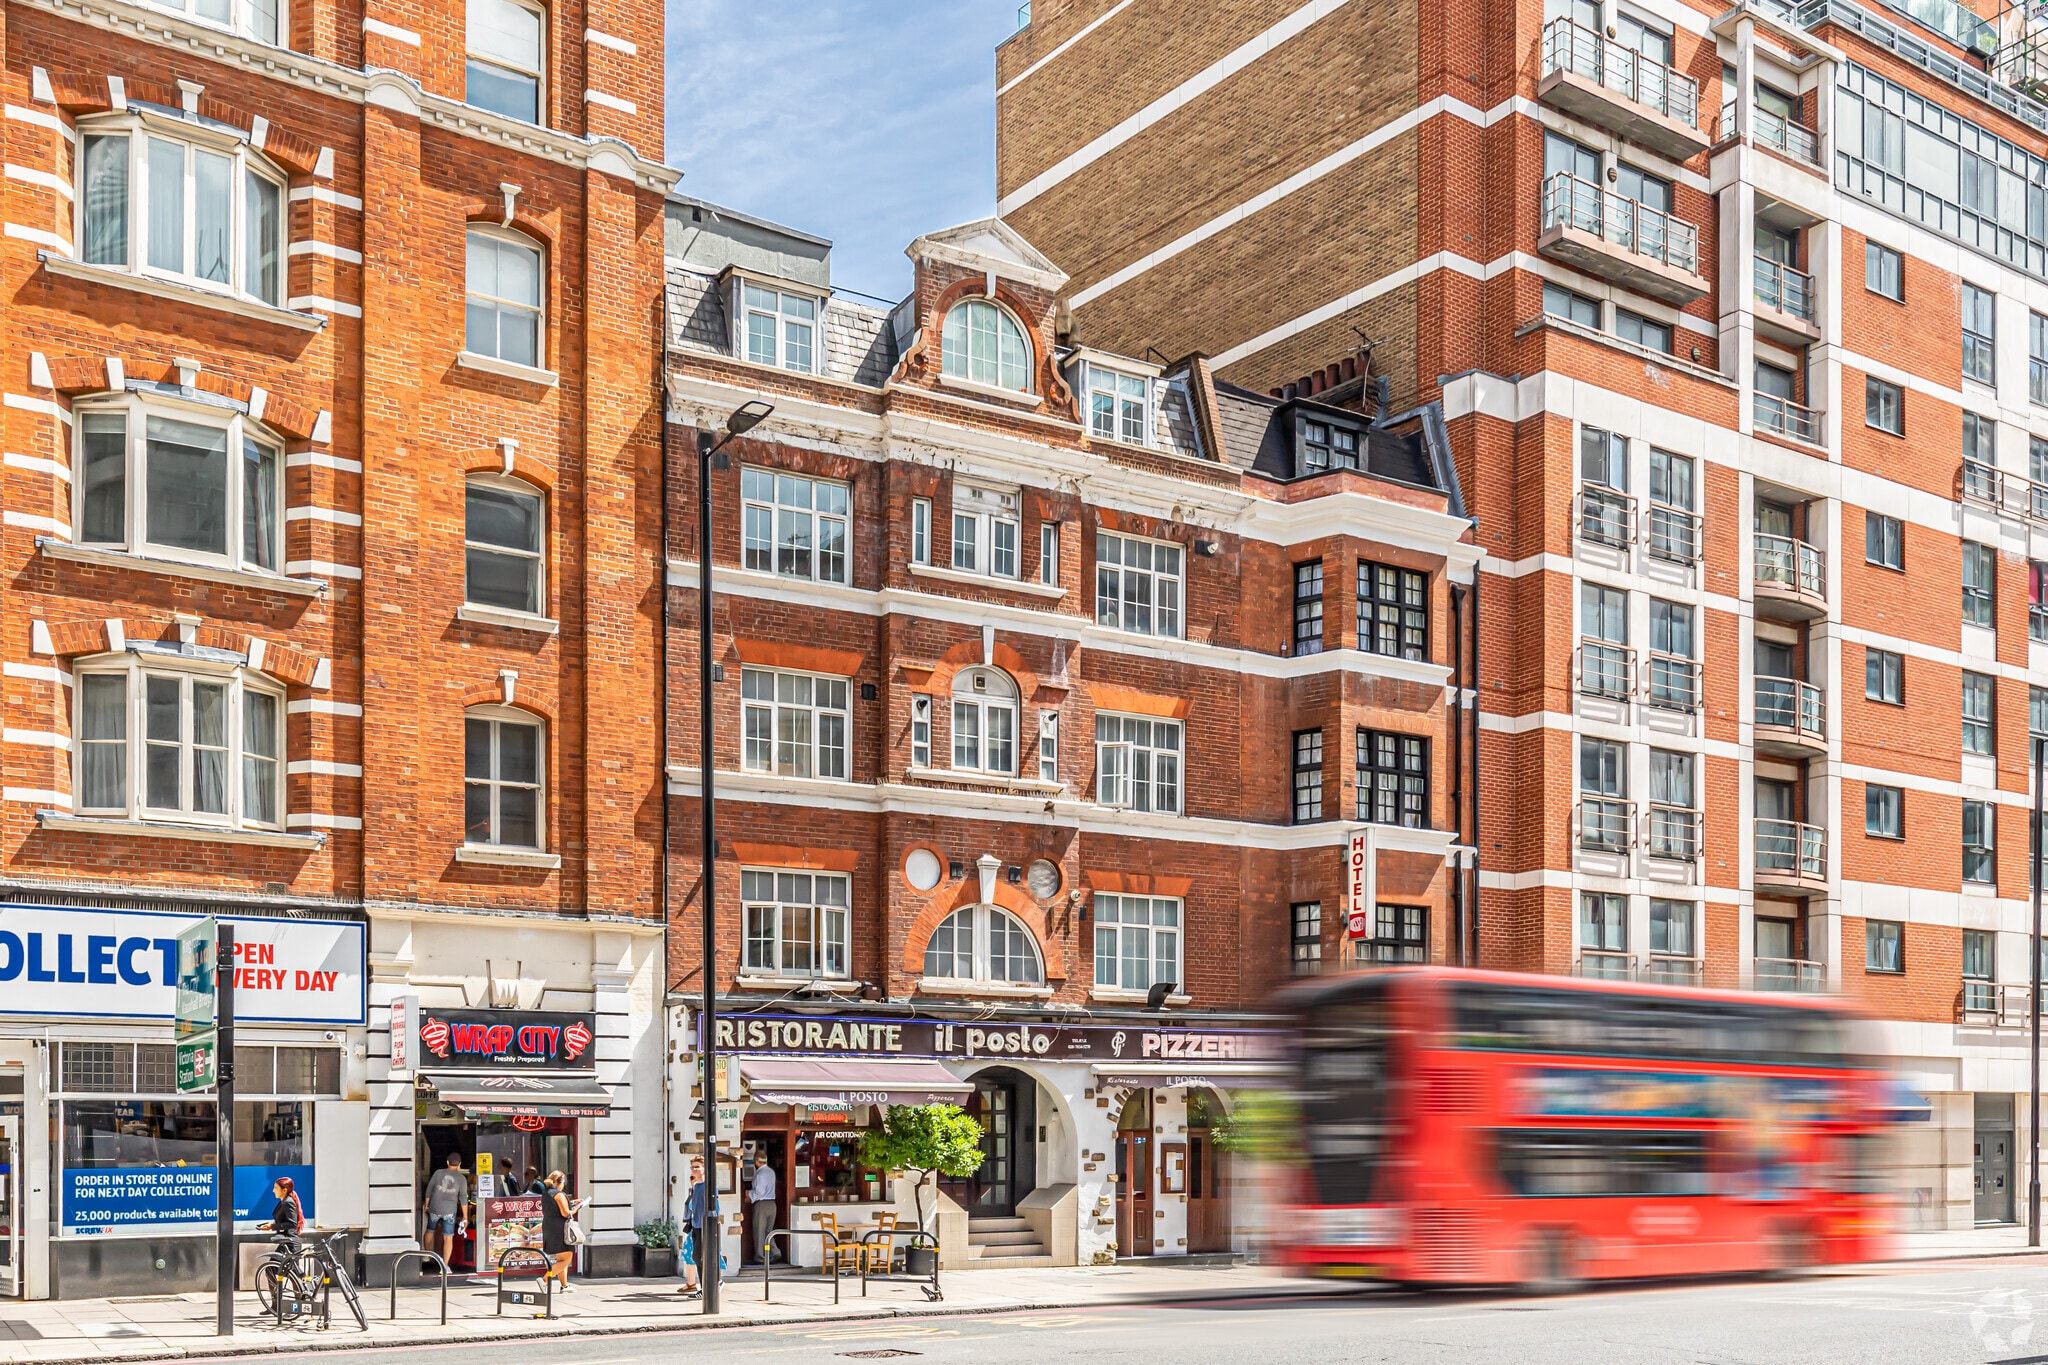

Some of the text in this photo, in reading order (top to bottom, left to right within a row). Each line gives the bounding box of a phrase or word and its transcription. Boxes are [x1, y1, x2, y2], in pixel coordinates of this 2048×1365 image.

[1352, 836, 1364, 911] HOTEL
[215, 941, 273, 965] PEN
[215, 968, 287, 990] VERY
[295, 970, 339, 992] DAY
[451, 1023, 561, 1058] WRAP CITY
[716, 1020, 903, 1051] RISTORANTE
[935, 1024, 953, 1051] il
[966, 1026, 1050, 1056] posto
[178, 1049, 194, 1064] Victoria
[494, 1055, 516, 1063] Freshly
[179, 1070, 194, 1084] Station
[1166, 1077, 1174, 1085] IL
[1175, 1076, 1206, 1085] POSTO
[839, 1092, 848, 1102] IL
[850, 1092, 888, 1103] POSTO
[807, 1102, 853, 1112] RISTORANTE
[512, 1115, 547, 1127] OPEN
[814, 1131, 825, 1139] AIR
[75, 1174, 213, 1186] ORDER IN STORE OR ONLINE
[75, 1186, 210, 1198] FOR NEXT DAY COLLECTION
[504, 1201, 534, 1212] WRAP
[75, 1211, 111, 1222] 25,000
[114, 1209, 157, 1222] products
[159, 1208, 201, 1219] available
